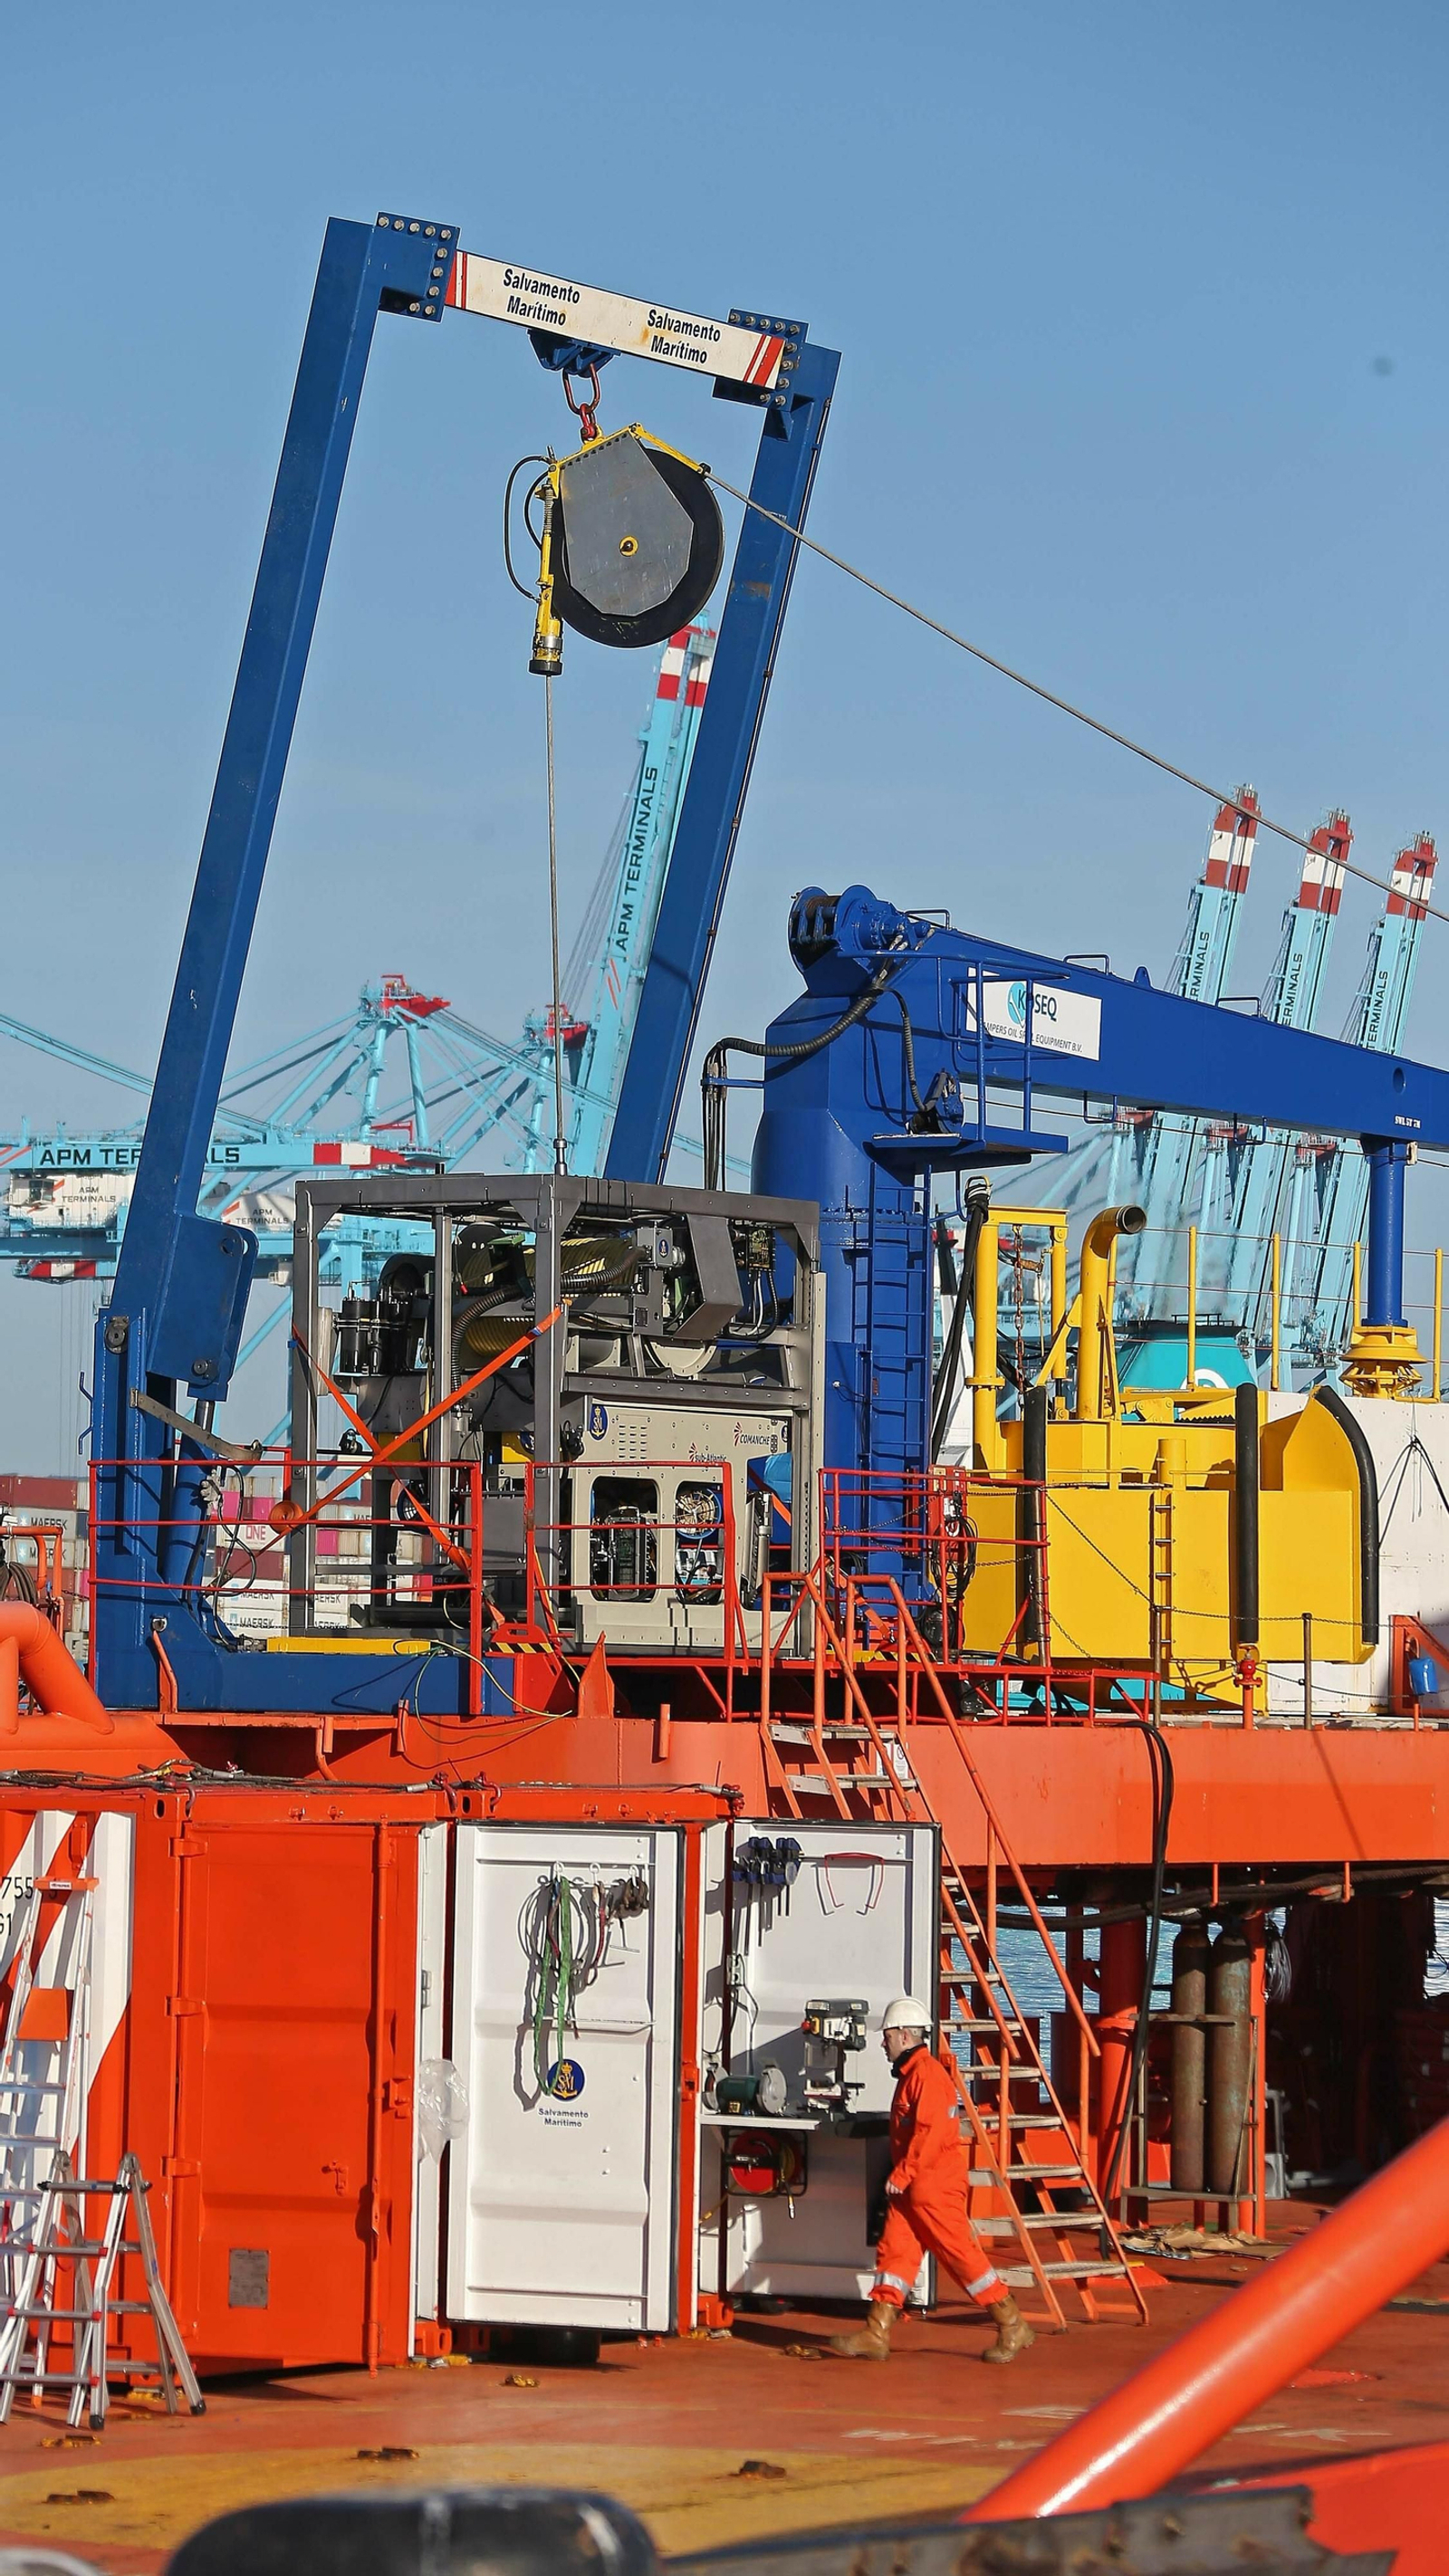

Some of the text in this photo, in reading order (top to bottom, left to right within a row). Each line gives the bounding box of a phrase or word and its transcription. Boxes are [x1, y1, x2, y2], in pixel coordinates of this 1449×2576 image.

[503, 268, 581, 304] Salvamento
[506, 295, 567, 327] Marítimo
[648, 309, 721, 343] Salvamento
[651, 335, 708, 364] Marítimo
[616, 767, 657, 952] APM TERMINALS
[1190, 932, 1210, 1000] RMINALS
[1018, 989, 1058, 1021] KSEQ
[1281, 953, 1303, 1025] ERMINALS
[1036, 1034, 1072, 1049] EQUIPMENT
[1072, 1043, 1083, 1053] B.V.
[40, 1149, 91, 1165] APM
[740, 1434, 770, 1445] COMANCHE
[246, 1525, 266, 1540] ONE
[538, 2108, 589, 2118] Salvamento
